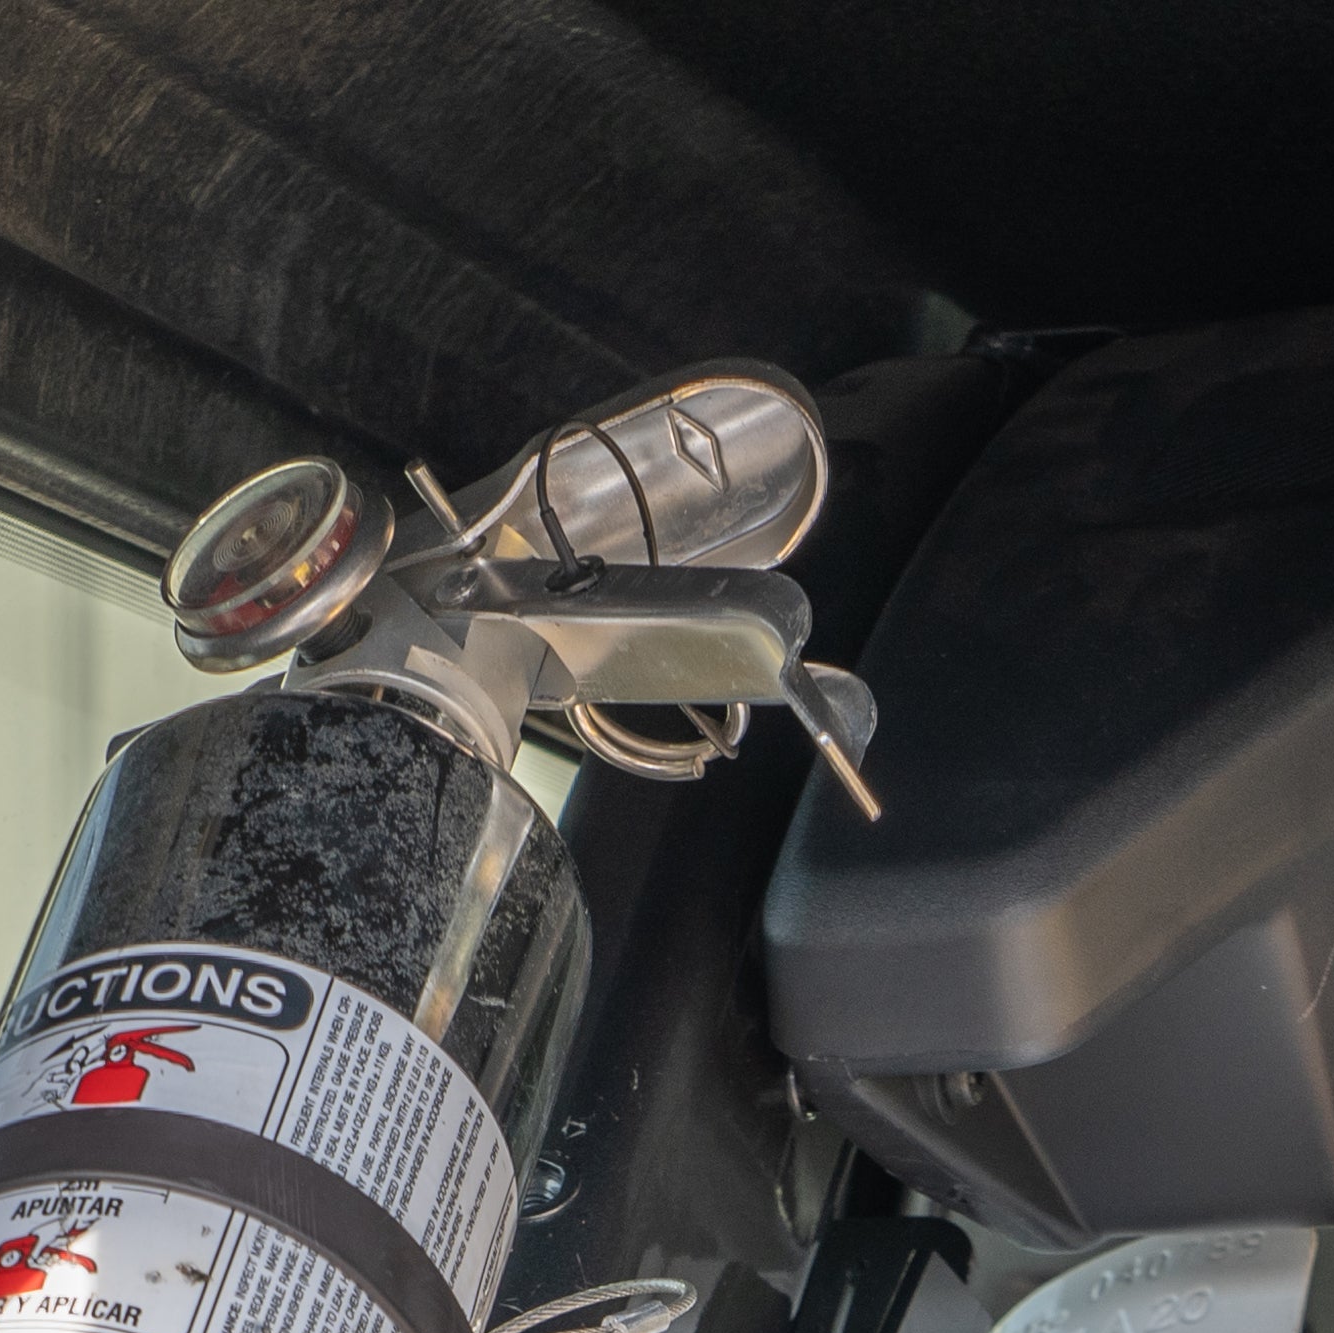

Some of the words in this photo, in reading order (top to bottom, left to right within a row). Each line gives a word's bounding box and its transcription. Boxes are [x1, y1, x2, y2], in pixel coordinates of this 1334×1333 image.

[0, 960, 287, 1046] UCTIONS
[330, 1051, 351, 1086] GAUGE
[343, 1001, 368, 1052] PRESSURE
[363, 1010, 384, 1046] GROSS
[291, 1095, 315, 1146] FREQUENT
[309, 1045, 333, 1095] INTERVALS
[326, 1014, 344, 1044] WHEN
[342, 1088, 356, 1107] BE
[348, 1076, 360, 1091] IN
[368, 1112, 389, 1152] PARTIAL
[383, 1056, 408, 1111] DISCHARGE
[401, 1032, 417, 1057] MAY
[392, 1151, 409, 1179] WITH
[401, 1105, 425, 1154] NITROGEN
[419, 1088, 431, 1106] TO
[429, 1054, 443, 1075] PSI
[425, 1066, 453, 1135] ACCORDANCE
[333, 1105, 351, 1133] MUST
[324, 1133, 341, 1159] SEAL
[374, 1126, 401, 1187] RECHARGED
[394, 1100, 411, 1128] WITH
[420, 1131, 431, 1147] IN
[437, 1143, 461, 1207] ACCORDANCE
[457, 1119, 469, 1145] WITH
[10, 1195, 125, 1222] APUNTAR
[263, 1243, 283, 1272] MAKE
[234, 1255, 258, 1300] INSPECT
[16, 1295, 32, 1314] Y
[34, 1295, 144, 1328] APLICAR
[324, 1308, 338, 1327] TO
